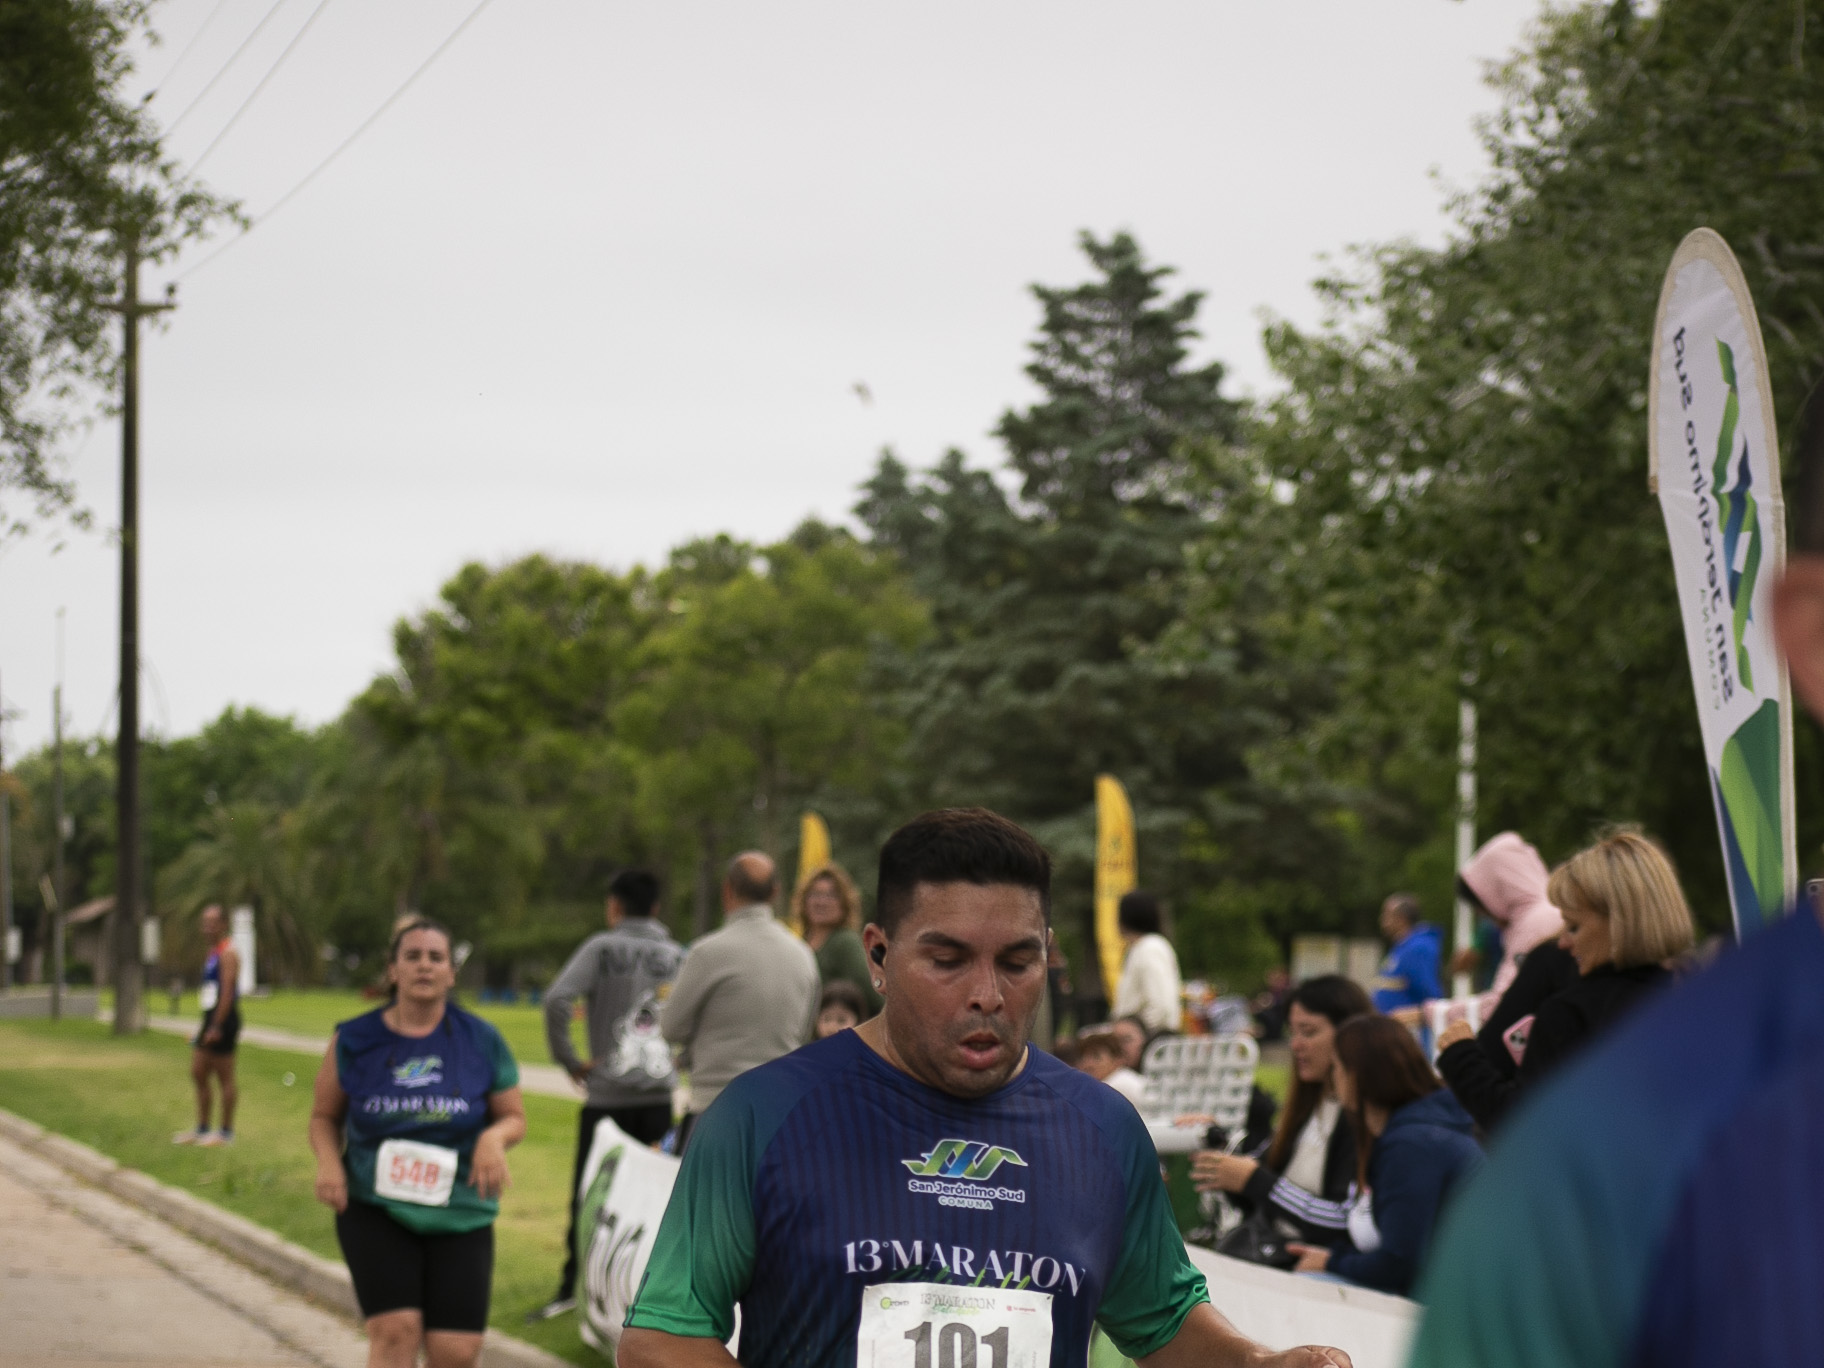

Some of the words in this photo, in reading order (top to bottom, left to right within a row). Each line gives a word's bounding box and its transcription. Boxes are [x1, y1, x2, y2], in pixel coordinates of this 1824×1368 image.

[390, 1154, 441, 1189] 548
[908, 1180, 933, 1193] San
[935, 1182, 996, 1198] Jerónimo
[997, 1188, 1024, 1202] Sud
[939, 1197, 993, 1210] COMUNA
[890, 1240, 1086, 1298] MARATON
